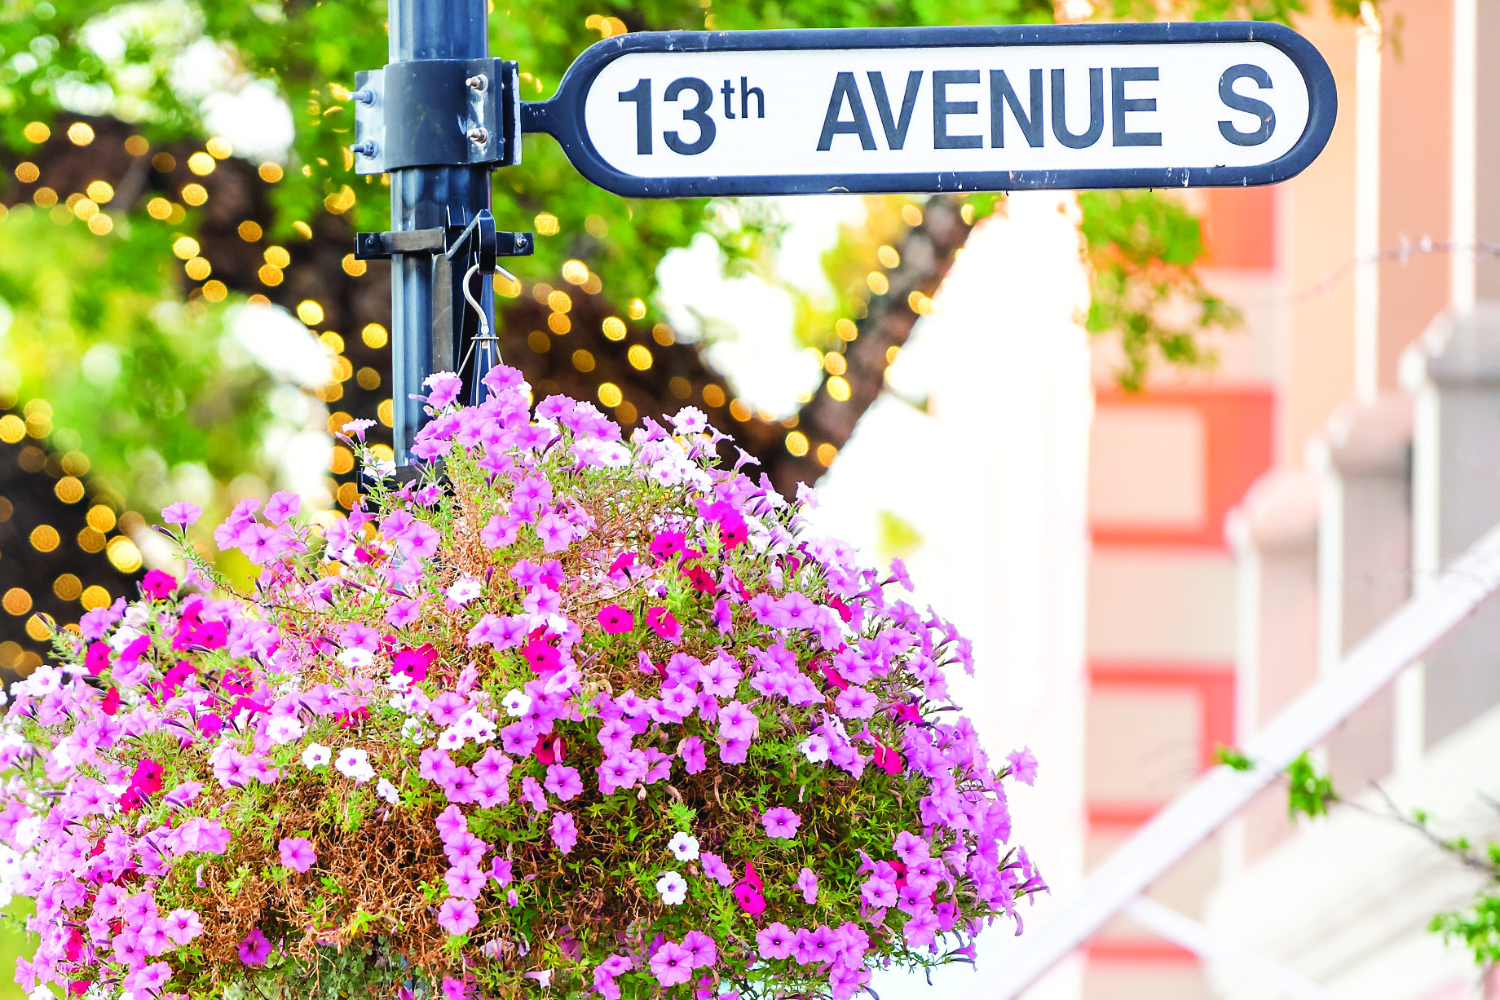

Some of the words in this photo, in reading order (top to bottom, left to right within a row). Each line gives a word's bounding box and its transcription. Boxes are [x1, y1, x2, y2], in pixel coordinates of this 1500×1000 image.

[616, 76, 766, 157] 13th
[815, 66, 1163, 152] AVENUE
[1216, 63, 1277, 148] S
